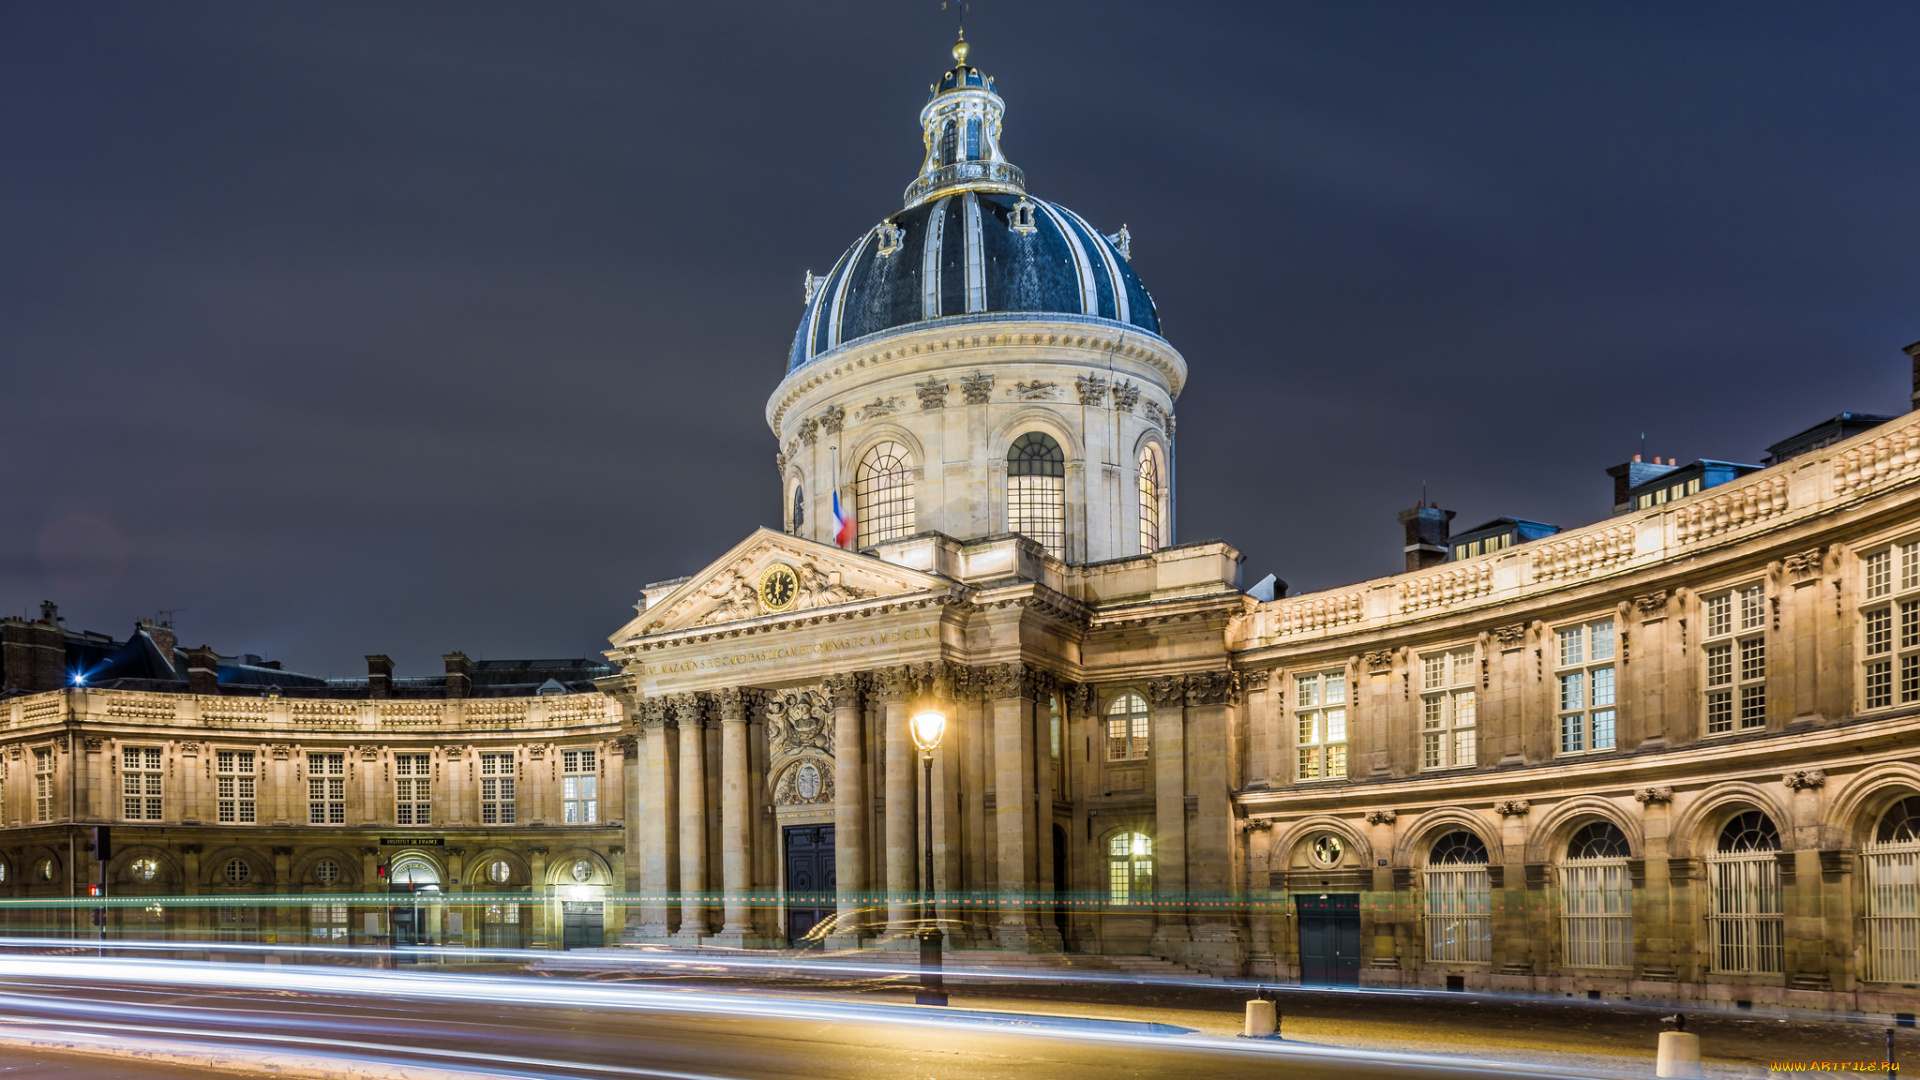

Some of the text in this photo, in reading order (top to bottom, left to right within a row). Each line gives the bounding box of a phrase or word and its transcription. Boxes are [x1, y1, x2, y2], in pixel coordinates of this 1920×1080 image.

[661, 661, 698, 674] MAZARIN
[749, 647, 798, 662] BASILICAM
[800, 644, 812, 655] ET
